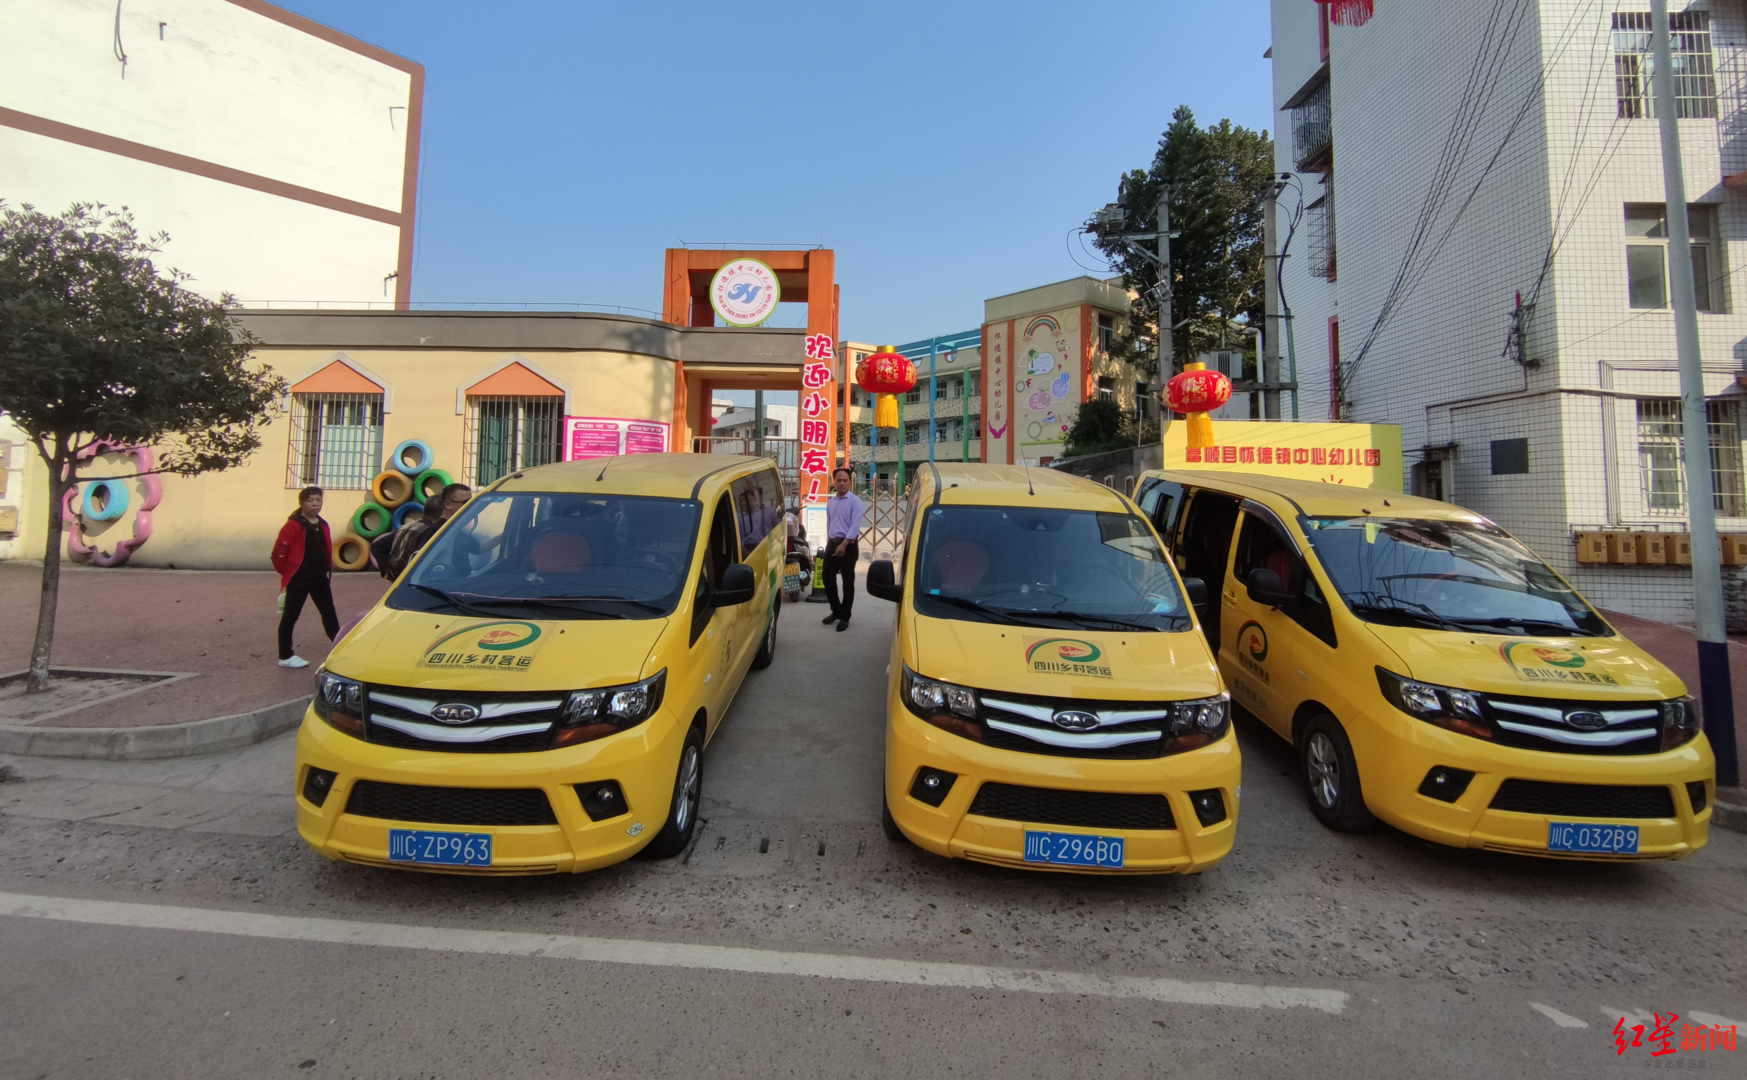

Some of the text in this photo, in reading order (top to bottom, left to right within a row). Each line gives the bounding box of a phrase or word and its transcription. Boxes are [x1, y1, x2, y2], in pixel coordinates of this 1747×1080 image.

[801, 333, 832, 502] 欢迎小朋友！
[1186, 446, 1381, 466] 富顺县怀德镇中心幼儿园
[428, 653, 533, 667] 四川乡村客运
[1034, 661, 1113, 677] 四川乡村客运
[1522, 668, 1618, 684] 四川乡村客运
[437, 707, 472, 718] JAC
[1060, 715, 1093, 724] JAC
[629, 824, 643, 834] CNG
[1551, 827, 1638, 849] 川C·032B9
[392, 834, 489, 861] 川C·ZP963
[1027, 836, 1122, 863] 川C·296B0
